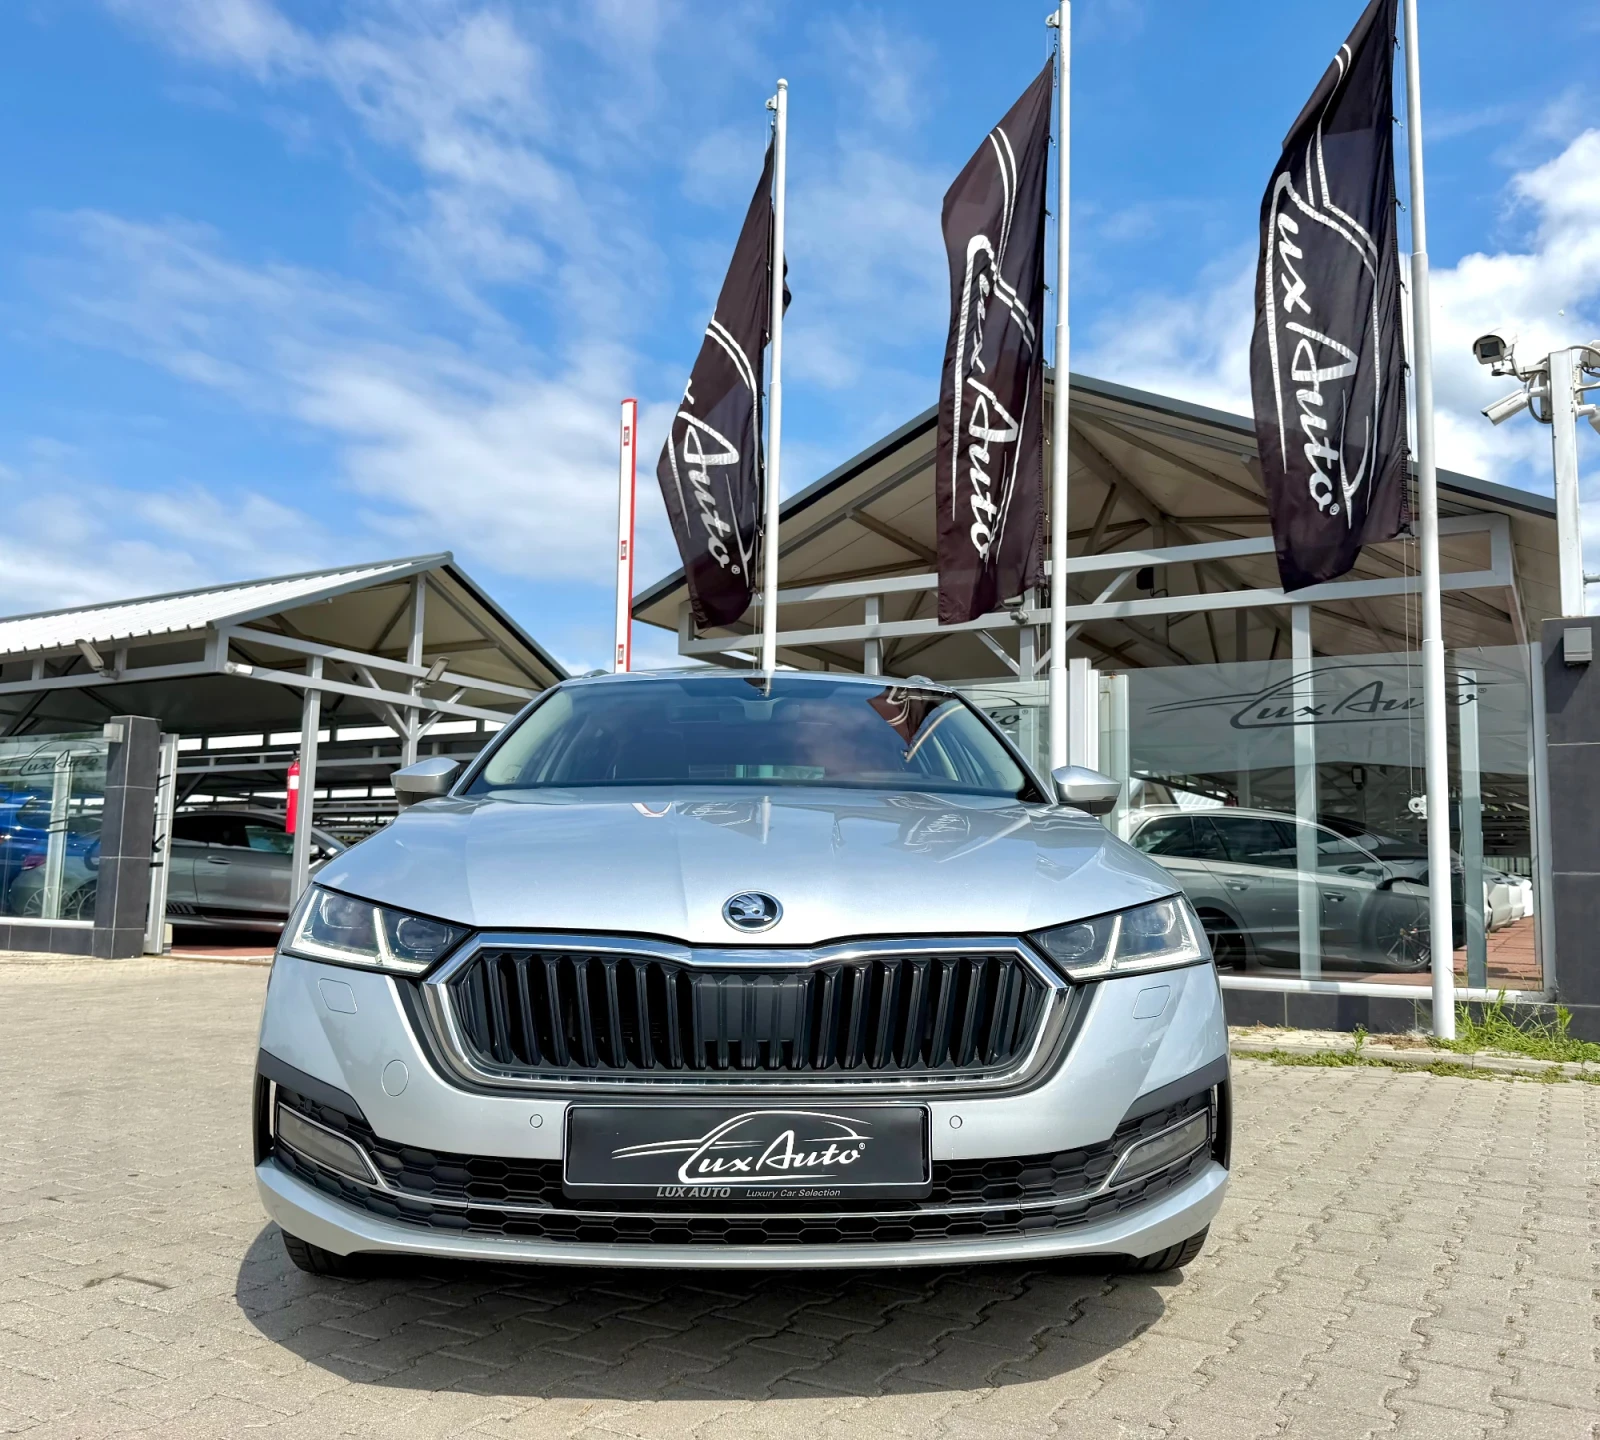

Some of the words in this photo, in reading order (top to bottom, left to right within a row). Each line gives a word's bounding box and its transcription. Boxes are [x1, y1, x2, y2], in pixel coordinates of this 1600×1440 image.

[656, 1187, 686, 1198] LUX
[688, 1187, 731, 1198] AUTO
[746, 1189, 778, 1199] Luxury
[780, 1189, 797, 1197] Car
[799, 1188, 841, 1197] Selection
